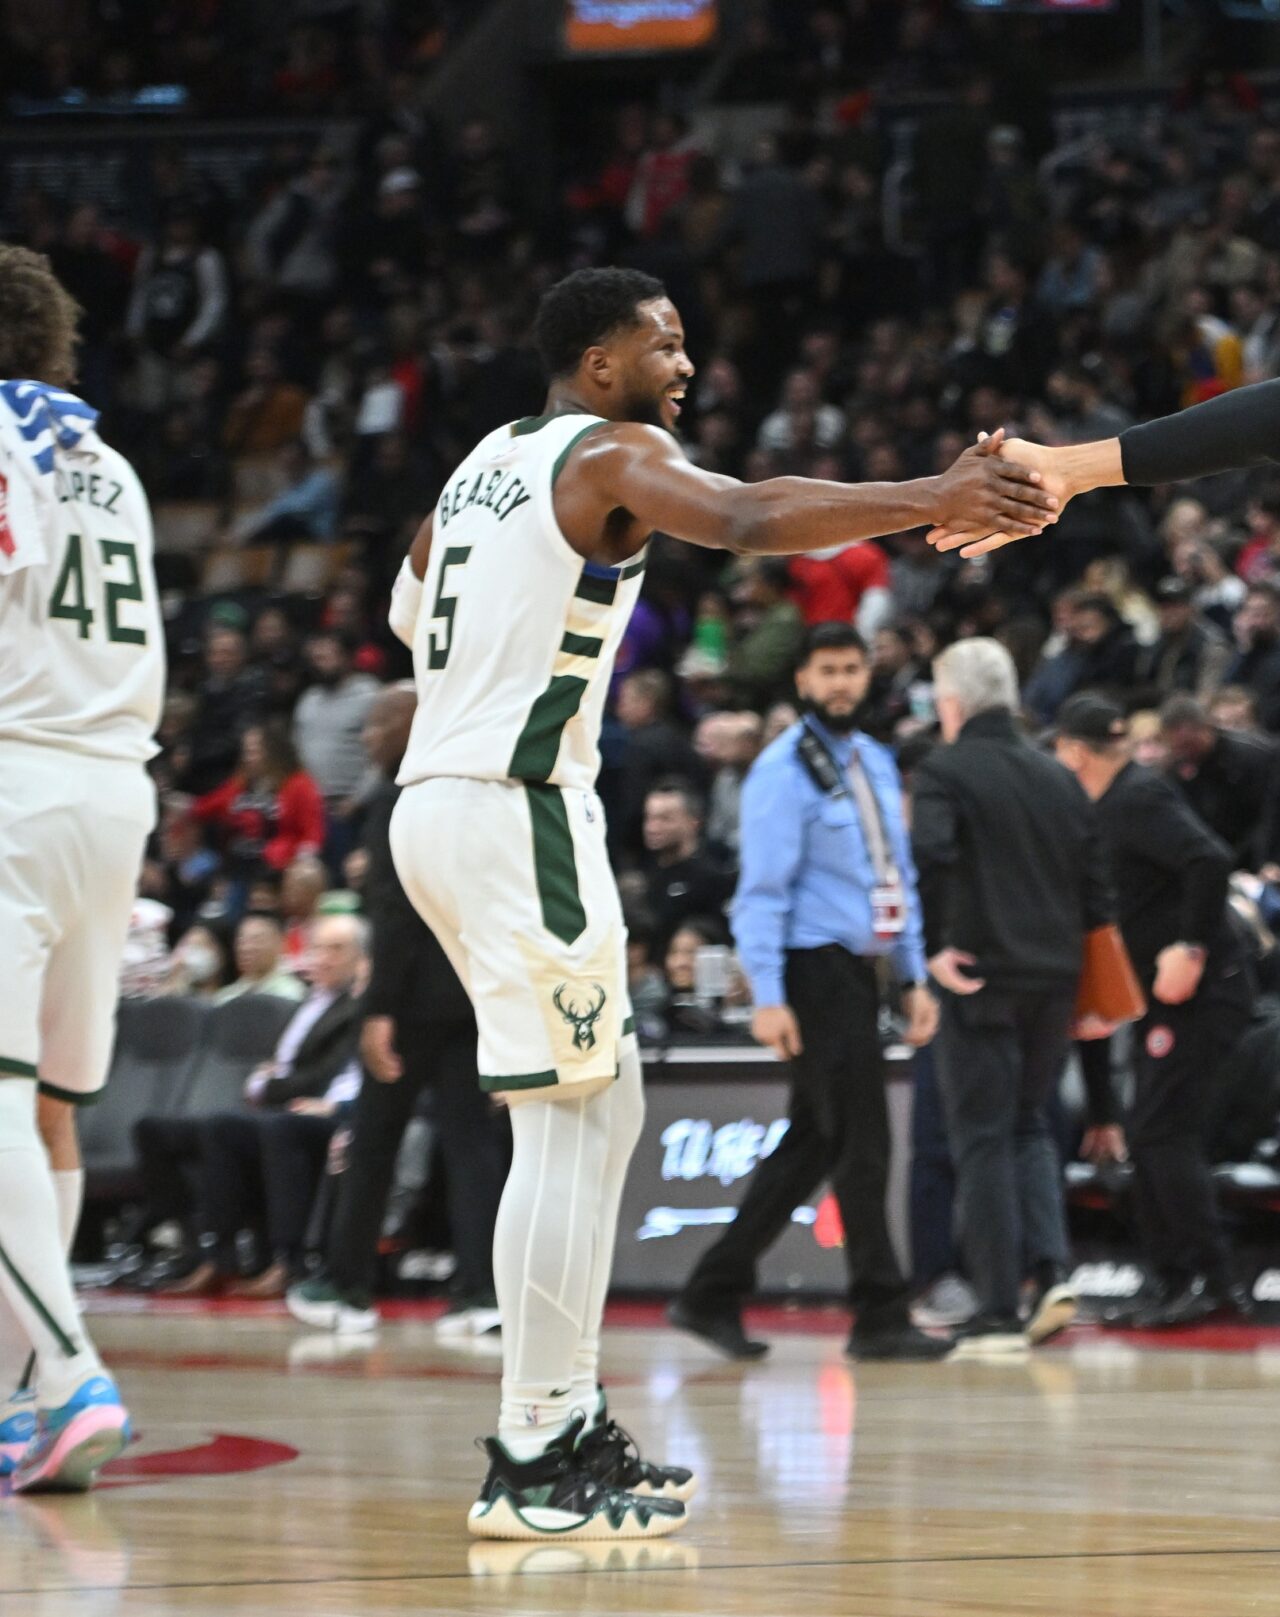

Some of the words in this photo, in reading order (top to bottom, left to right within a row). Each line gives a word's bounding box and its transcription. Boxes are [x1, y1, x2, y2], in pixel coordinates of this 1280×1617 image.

[440, 469, 531, 528] BEASLEY
[49, 534, 147, 646] 42
[428, 546, 473, 670] 5
